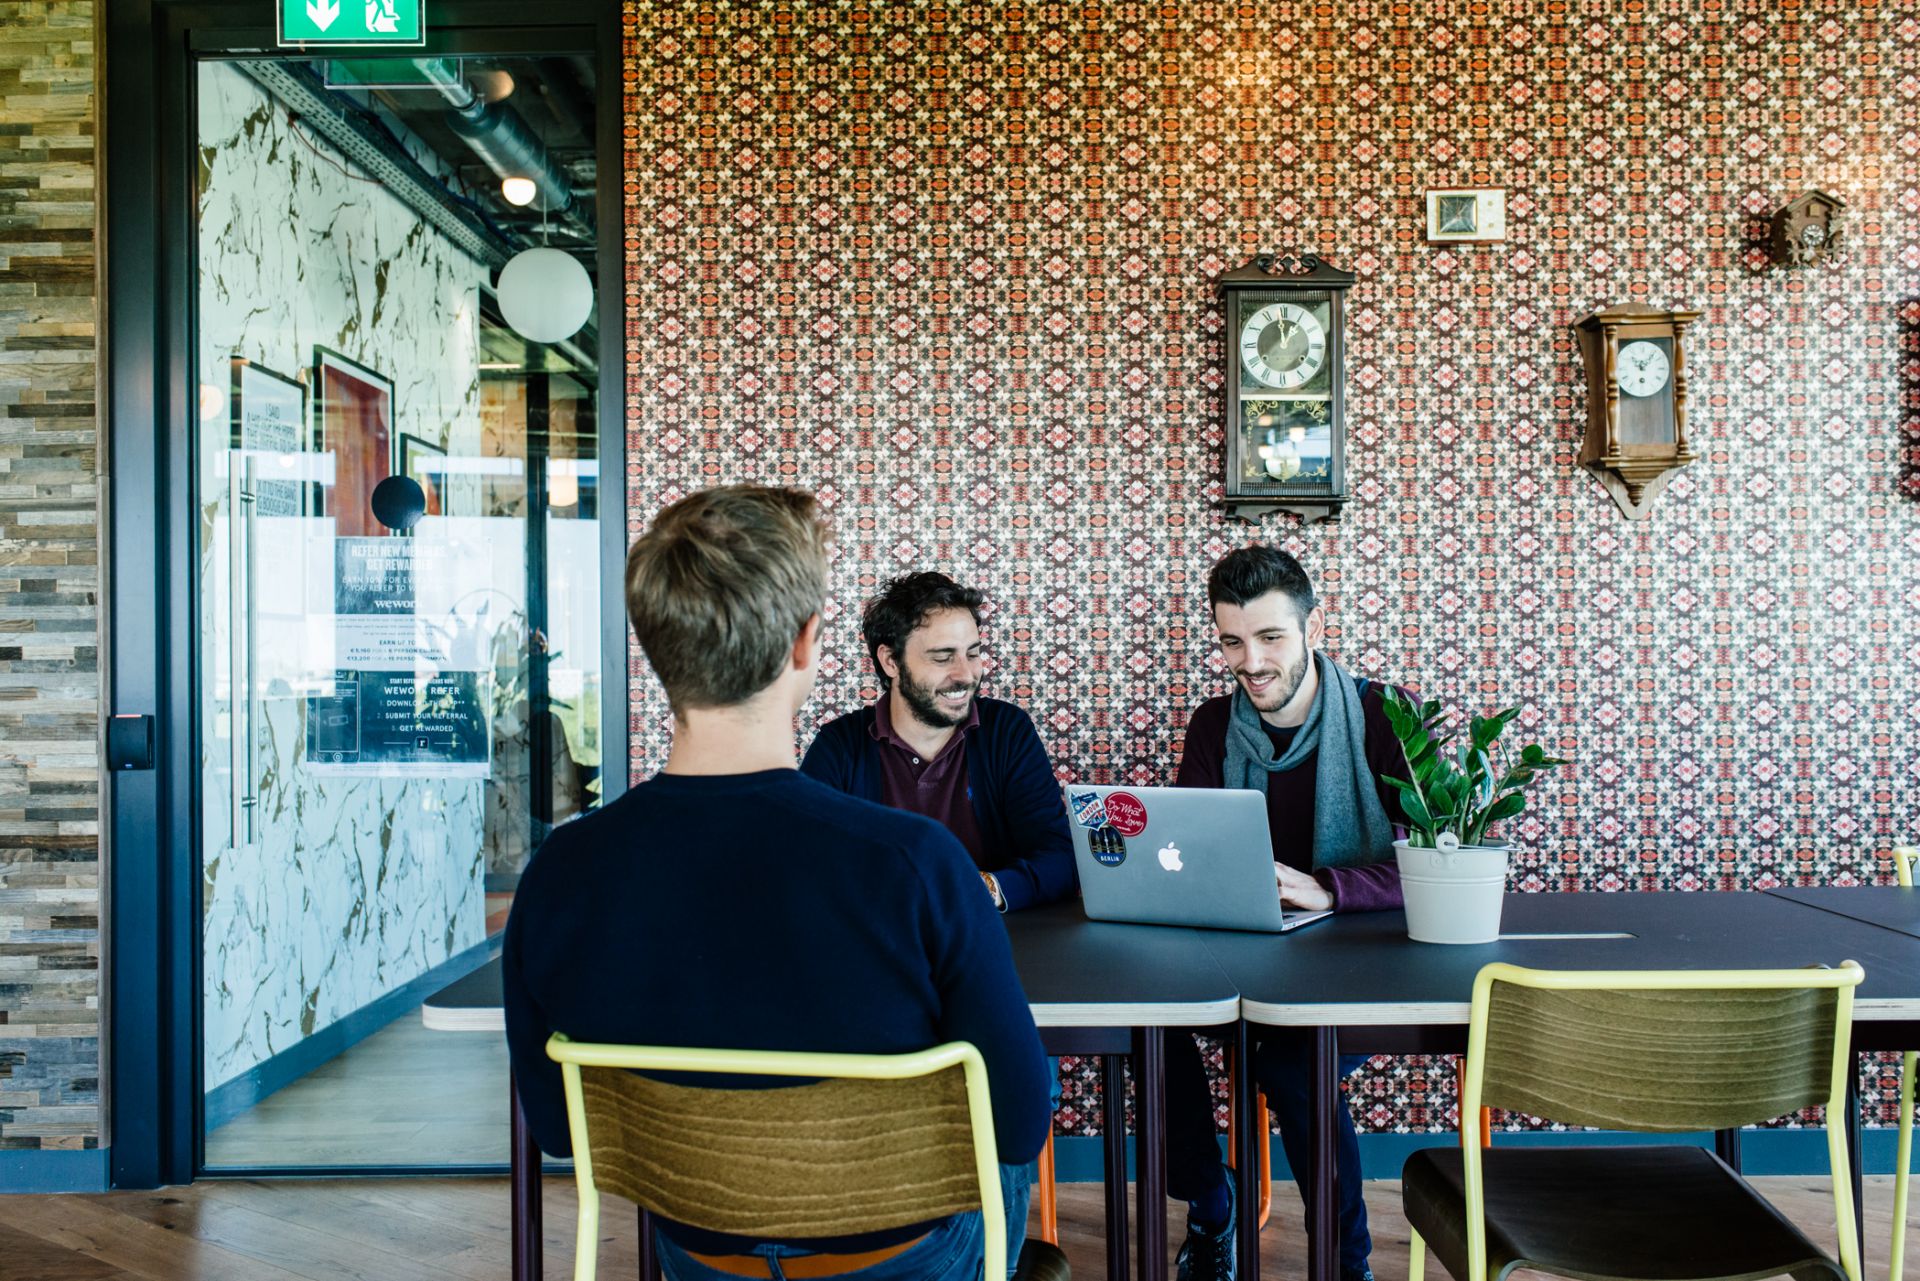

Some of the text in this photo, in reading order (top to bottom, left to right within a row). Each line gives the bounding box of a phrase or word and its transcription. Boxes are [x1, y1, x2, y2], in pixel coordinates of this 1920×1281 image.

[352, 545, 379, 557] REFER
[380, 545, 400, 557] NEW
[367, 559, 383, 571] GET
[384, 686, 460, 695] WEWOK REFER
[1080, 802, 1100, 820] LONDON
[1107, 799, 1144, 816] Do What
[1107, 810, 1123, 824] You
